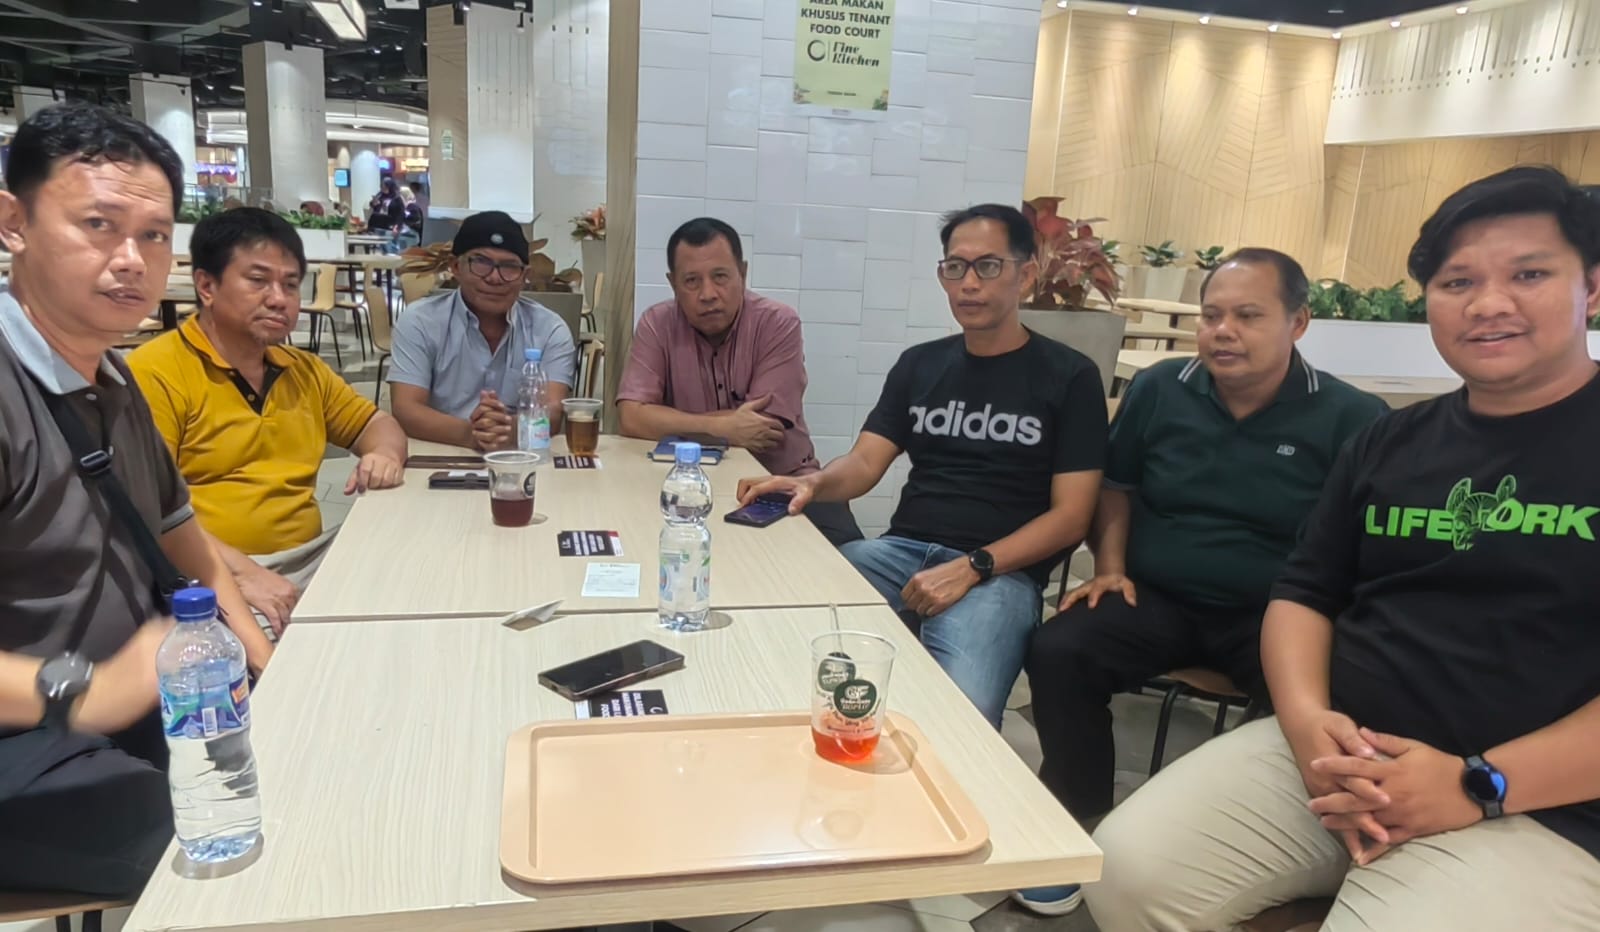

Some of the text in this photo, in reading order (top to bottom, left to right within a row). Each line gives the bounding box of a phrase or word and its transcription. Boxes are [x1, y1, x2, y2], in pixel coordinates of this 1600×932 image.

[841, 0, 884, 10] MAKAN
[800, 8, 891, 25] KHUSUS TENANT
[810, 23, 881, 39] FOOD COURT
[832, 53, 880, 67] Kitchen
[908, 400, 1042, 446] adidas
